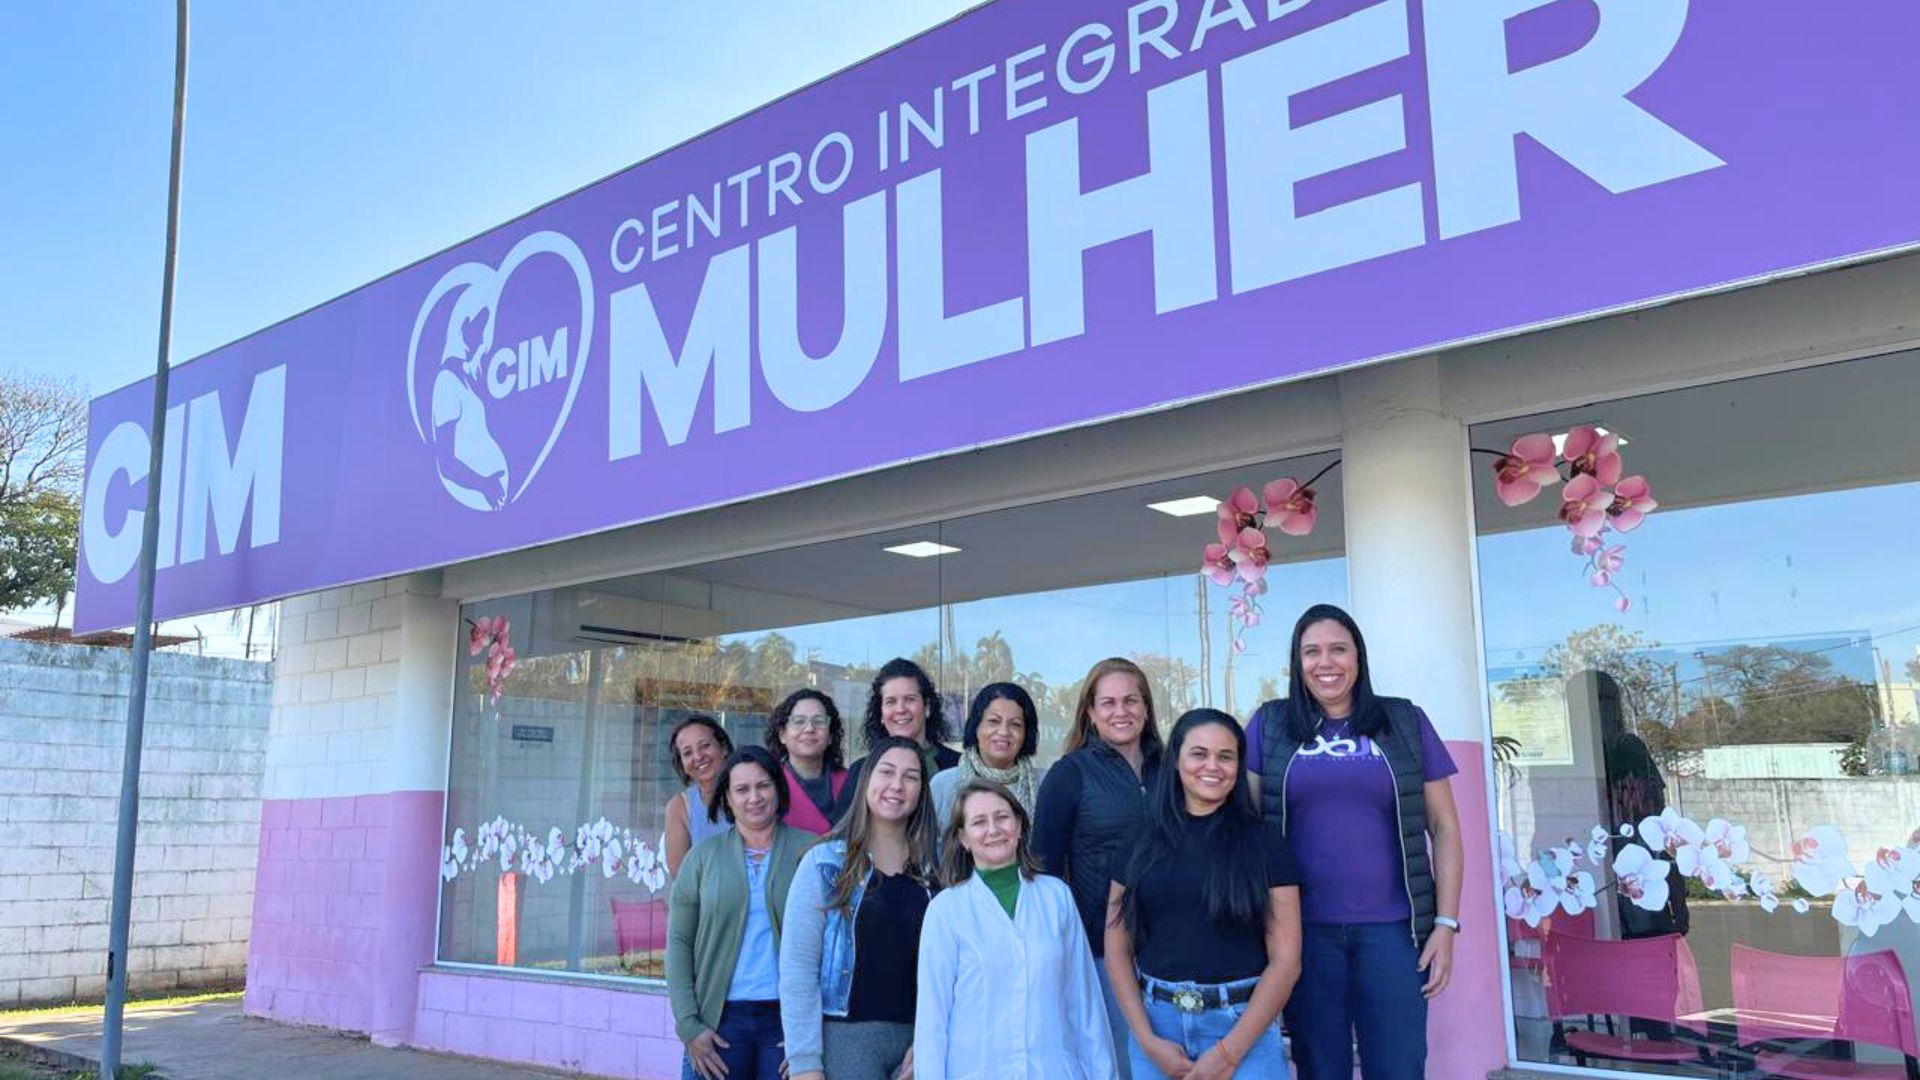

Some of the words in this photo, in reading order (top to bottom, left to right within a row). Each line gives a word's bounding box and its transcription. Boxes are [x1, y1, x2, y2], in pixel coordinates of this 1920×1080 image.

[609, 0, 1727, 462] MULHER
[610, 132, 854, 273] CENTRO
[879, 0, 1312, 172] INTEGRA
[83, 363, 287, 584] CIM
[487, 326, 569, 399] CIM
